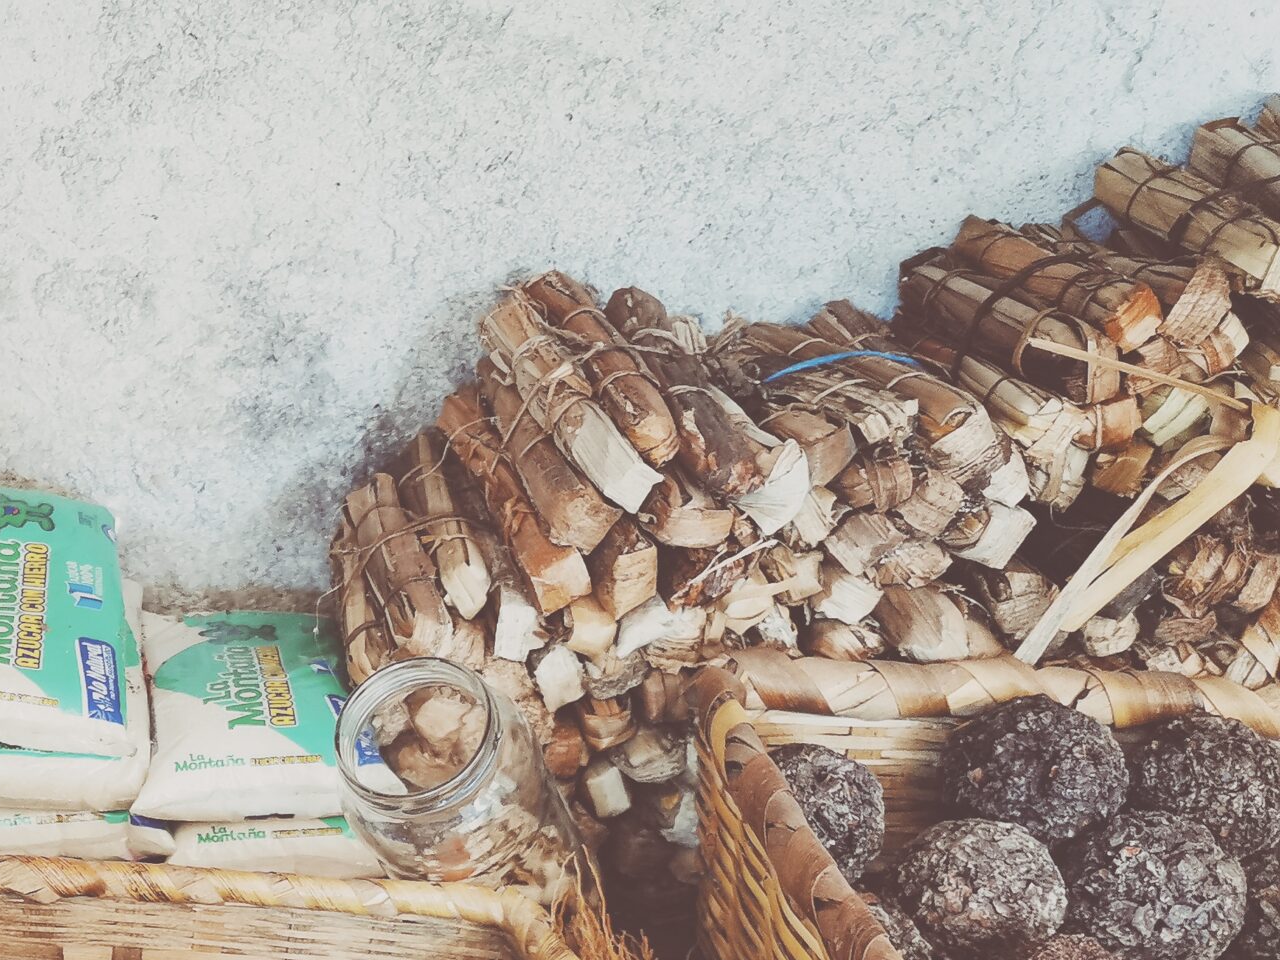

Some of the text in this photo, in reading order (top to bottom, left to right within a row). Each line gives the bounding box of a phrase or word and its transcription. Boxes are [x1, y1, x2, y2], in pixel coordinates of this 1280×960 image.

[15, 543, 49, 669] AZUCAR CON HIERRO
[203, 681, 231, 705] La
[264, 680, 297, 727] AZUCAR
[174, 755, 246, 773] Montaña
[189, 753, 205, 761] La
[211, 826, 227, 835] La
